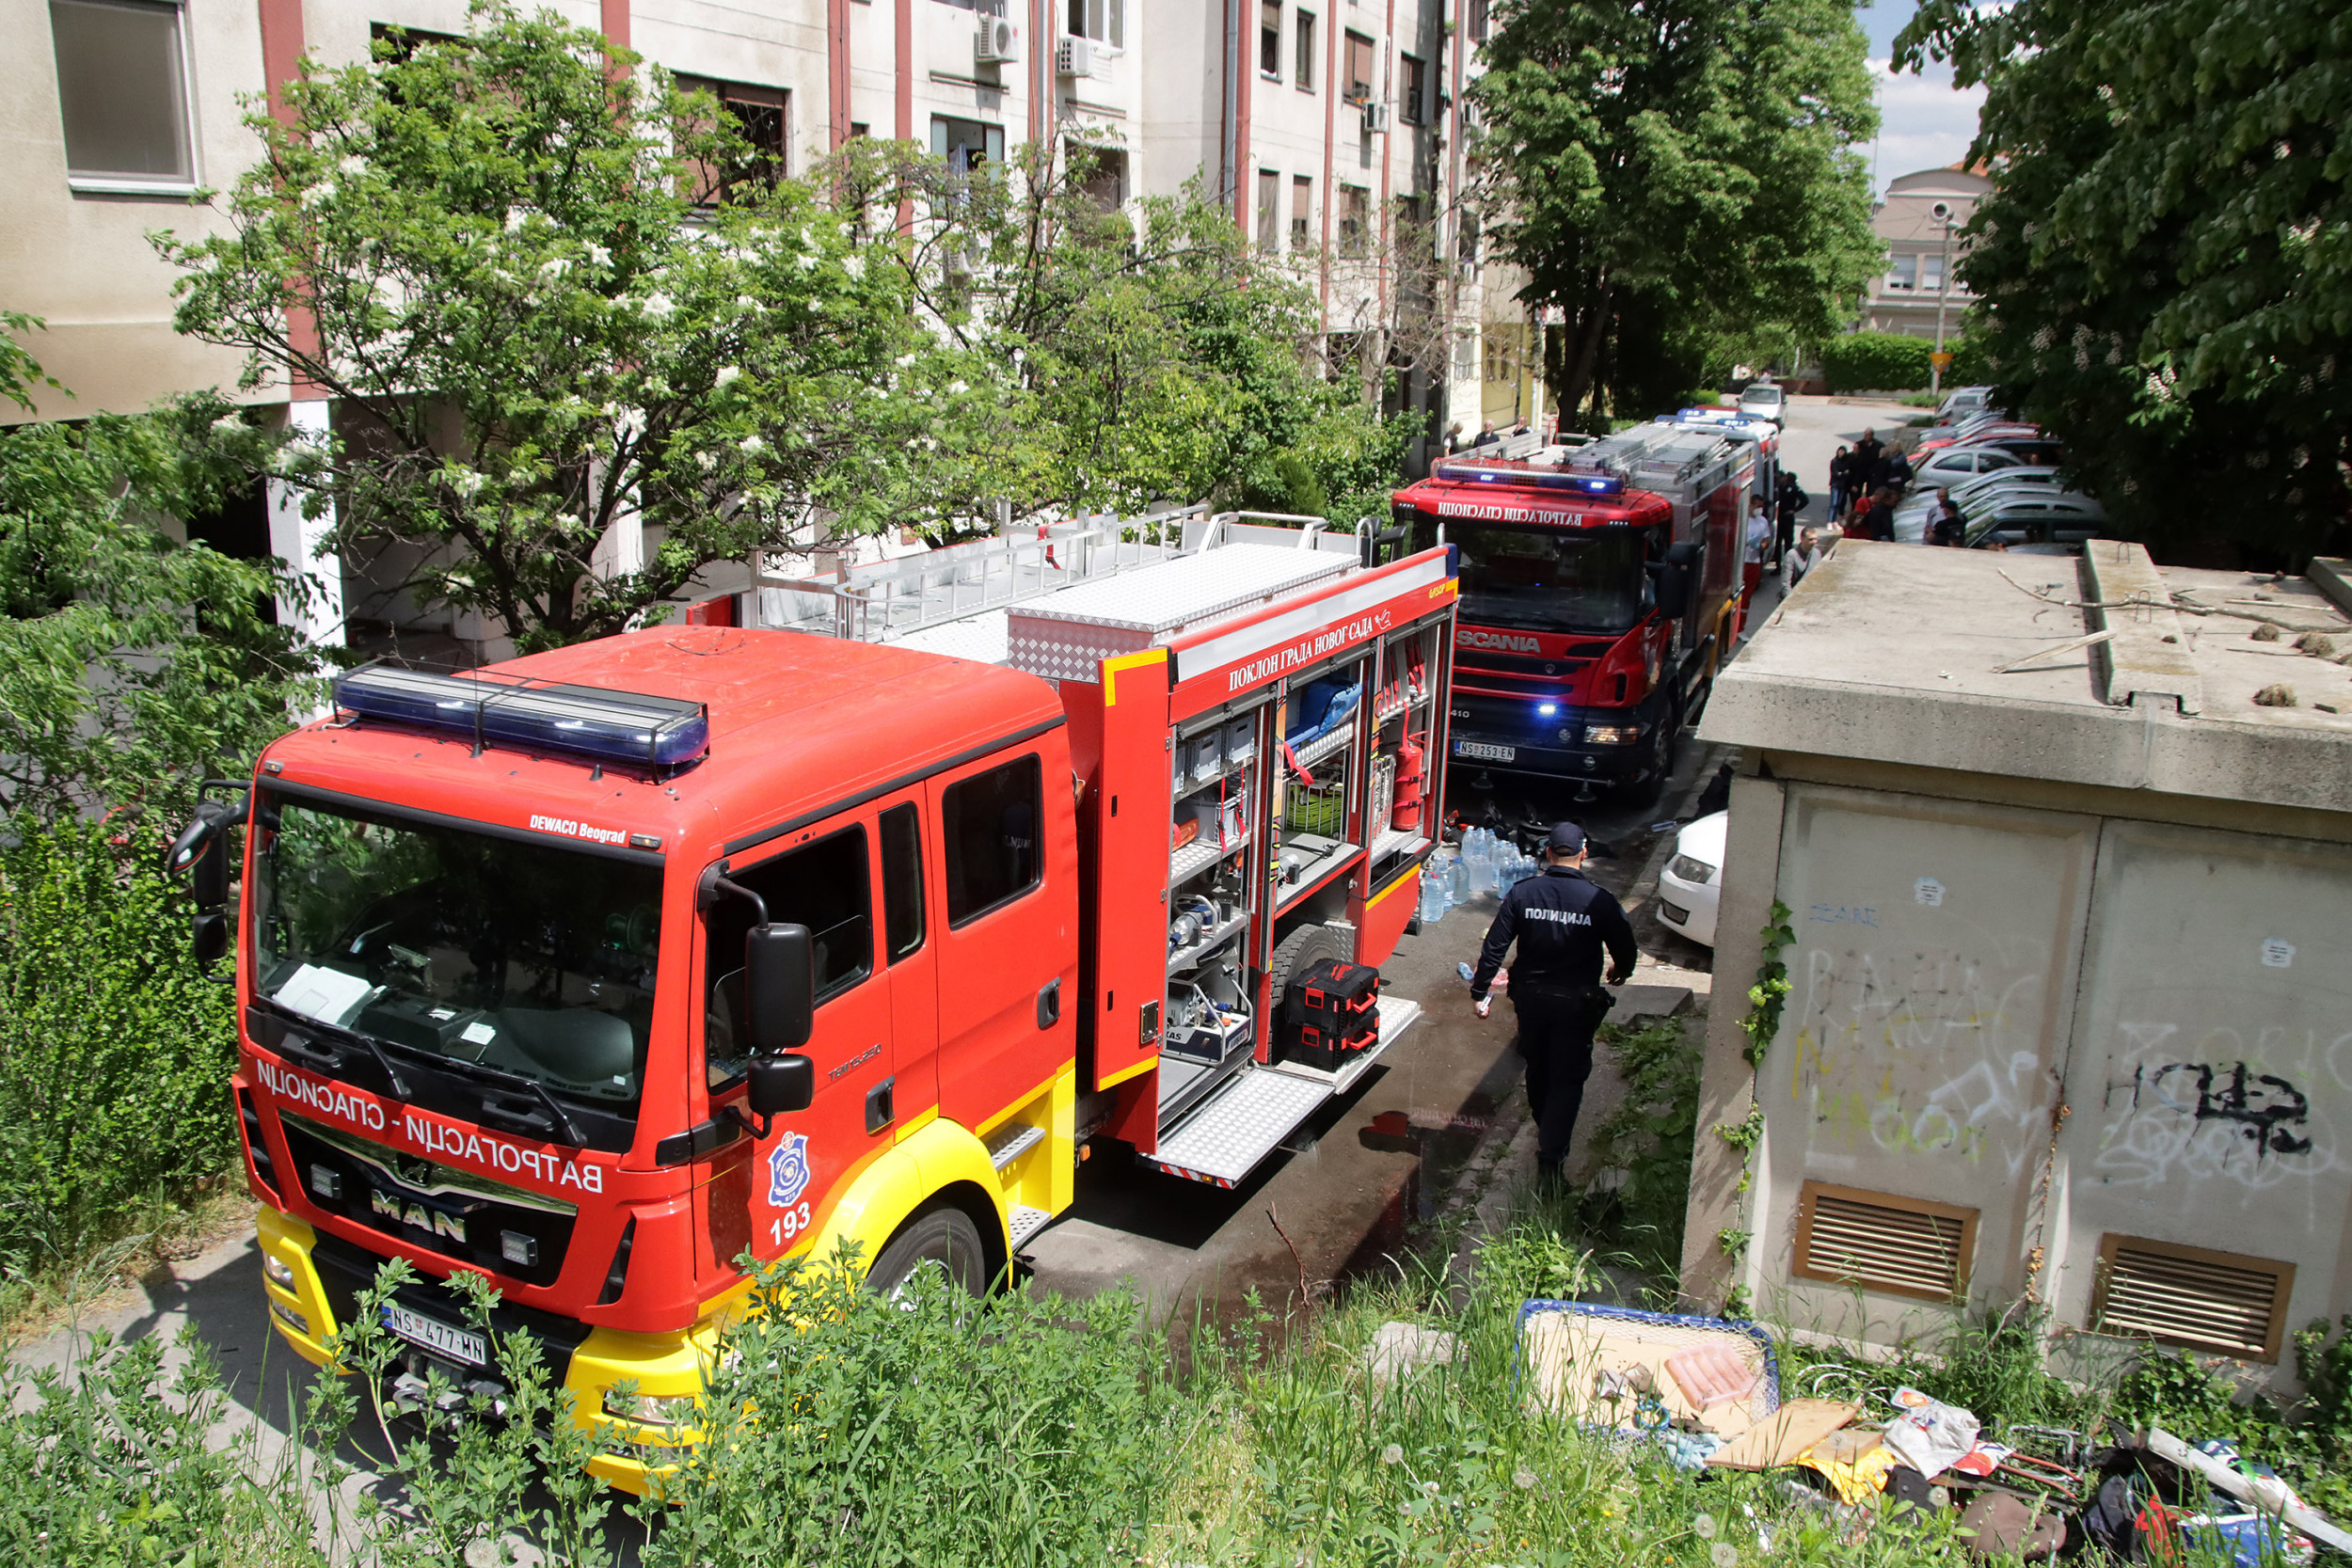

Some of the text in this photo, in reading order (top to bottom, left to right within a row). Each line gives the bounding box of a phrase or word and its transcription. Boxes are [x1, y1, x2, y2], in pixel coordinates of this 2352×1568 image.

[1455, 630, 1541, 653] SCANIA
[1229, 616, 1373, 692] ПОКЛОН ГРАДА НОВОГ САДА
[1450, 709, 1470, 718] 410
[1461, 741, 1473, 753] NS
[529, 815, 626, 844] DEWACO Beograd
[1525, 908, 1592, 927] ПОЛИЦИЈА
[828, 1062, 849, 1081] TGM
[372, 1188, 467, 1243] MAN
[770, 1201, 811, 1246] 193
[394, 1308, 412, 1332] NS
